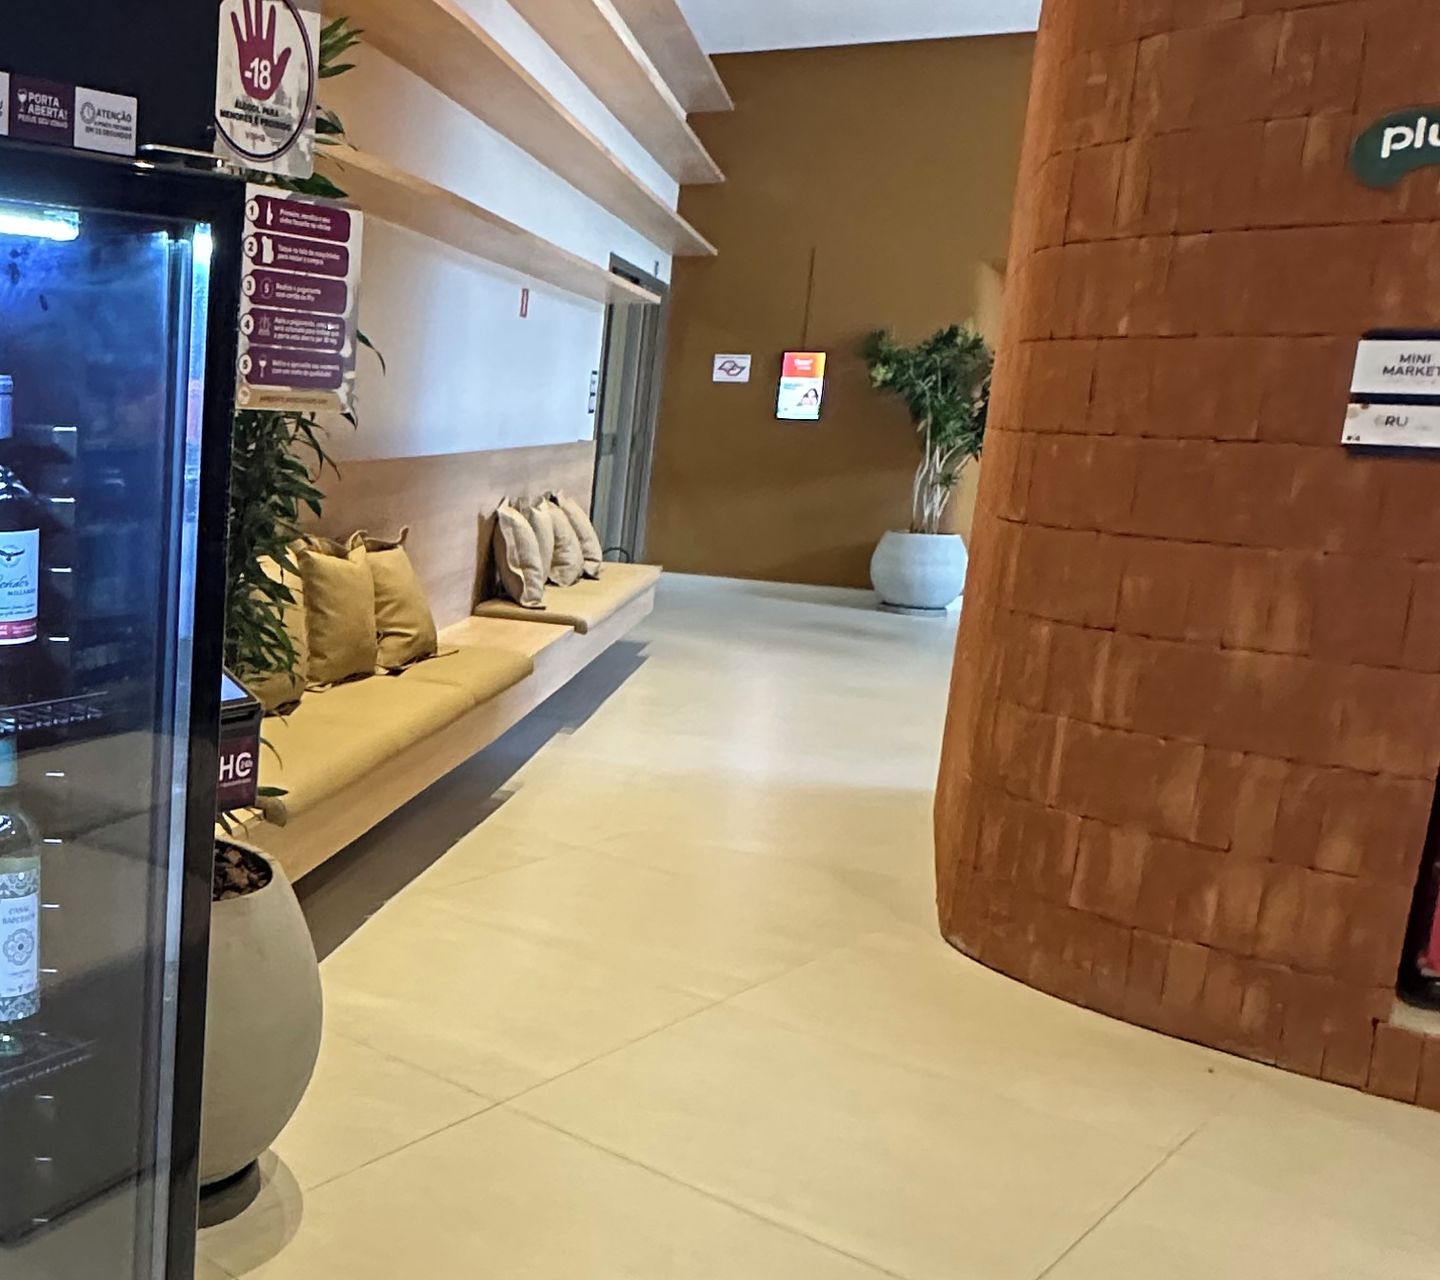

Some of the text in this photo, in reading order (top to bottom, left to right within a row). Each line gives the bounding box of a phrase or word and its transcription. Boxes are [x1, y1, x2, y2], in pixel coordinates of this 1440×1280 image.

[244, 57, 271, 90] -18
[28, 91, 60, 107] PORTA
[27, 104, 68, 120] ABERTA!
[96, 108, 132, 124] ATENÇÃO
[247, 242, 253, 251] 2
[246, 281, 252, 290] 3
[244, 320, 250, 329] 4
[1399, 353, 1431, 363] MINI
[242, 359, 248, 368] 5
